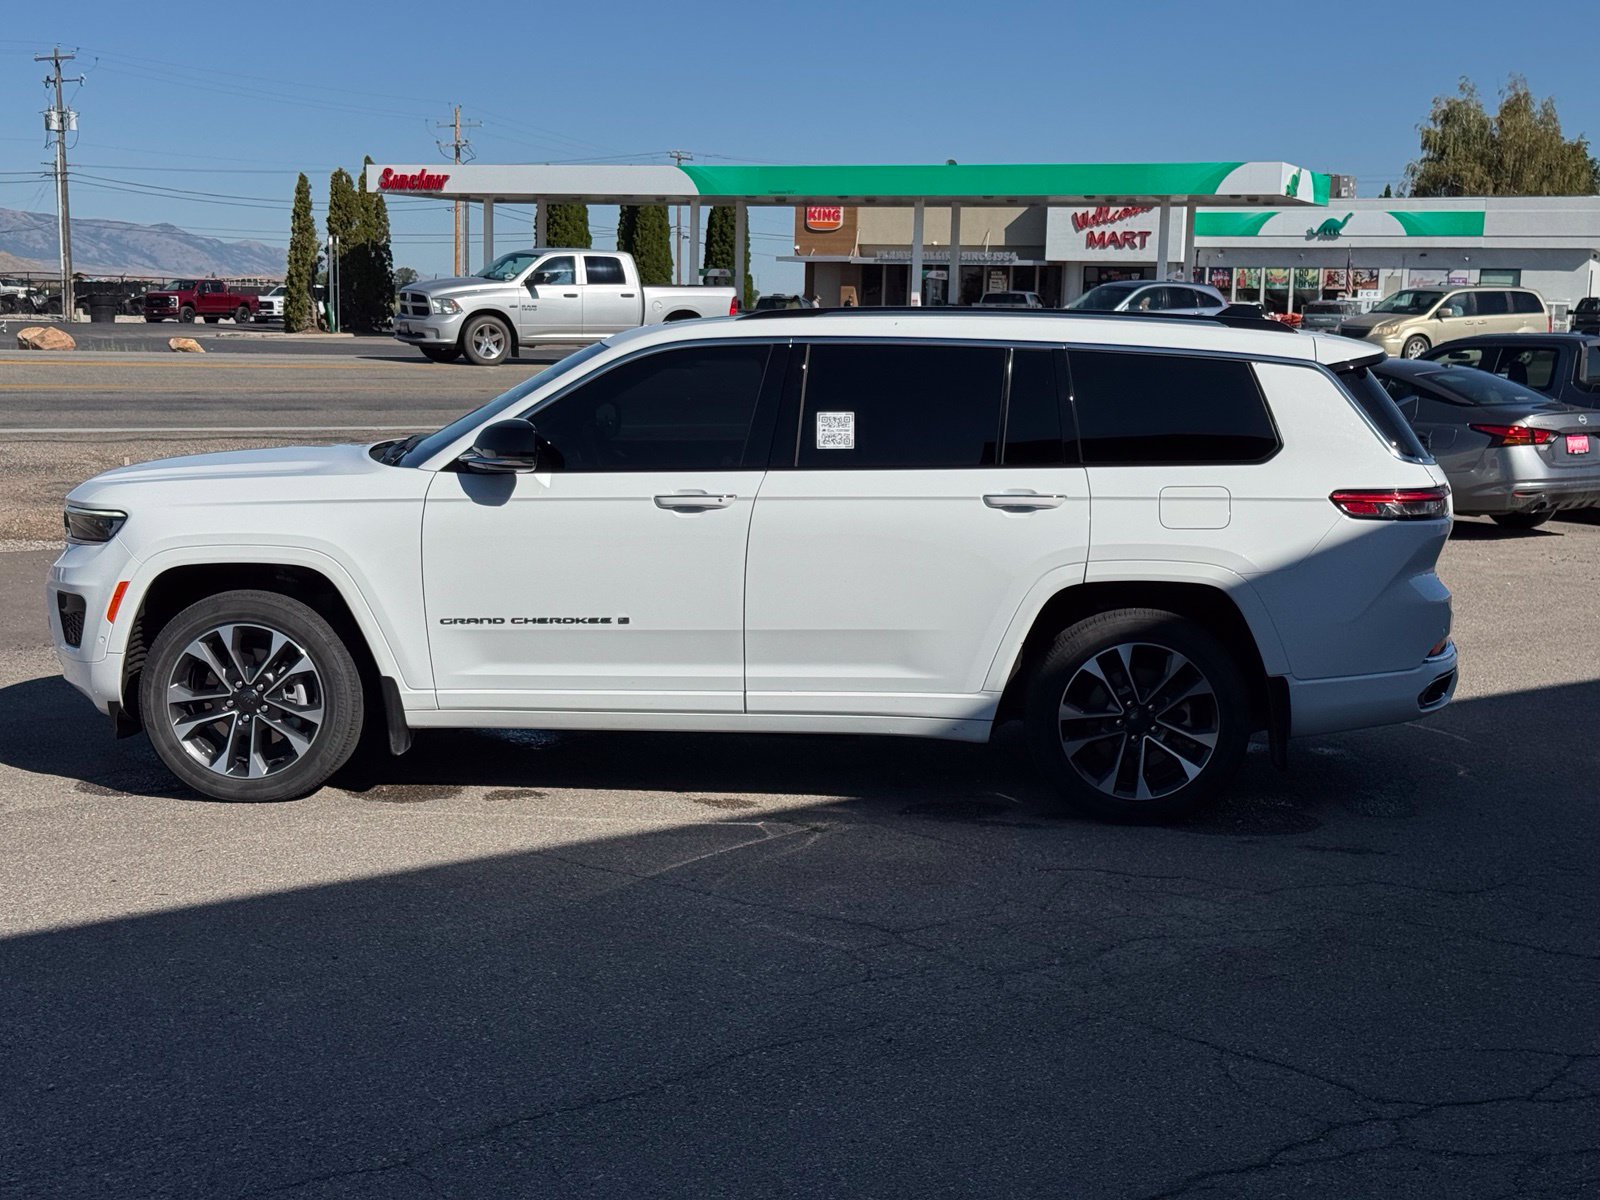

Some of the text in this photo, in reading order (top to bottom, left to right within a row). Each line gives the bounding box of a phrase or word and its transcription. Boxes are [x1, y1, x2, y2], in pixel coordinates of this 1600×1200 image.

[379, 167, 450, 191] Sinclair
[808, 209, 841, 221] KING
[1085, 231, 1152, 250] MART
[439, 617, 505, 625] GRAND
[510, 617, 613, 625] CHEROKEE
